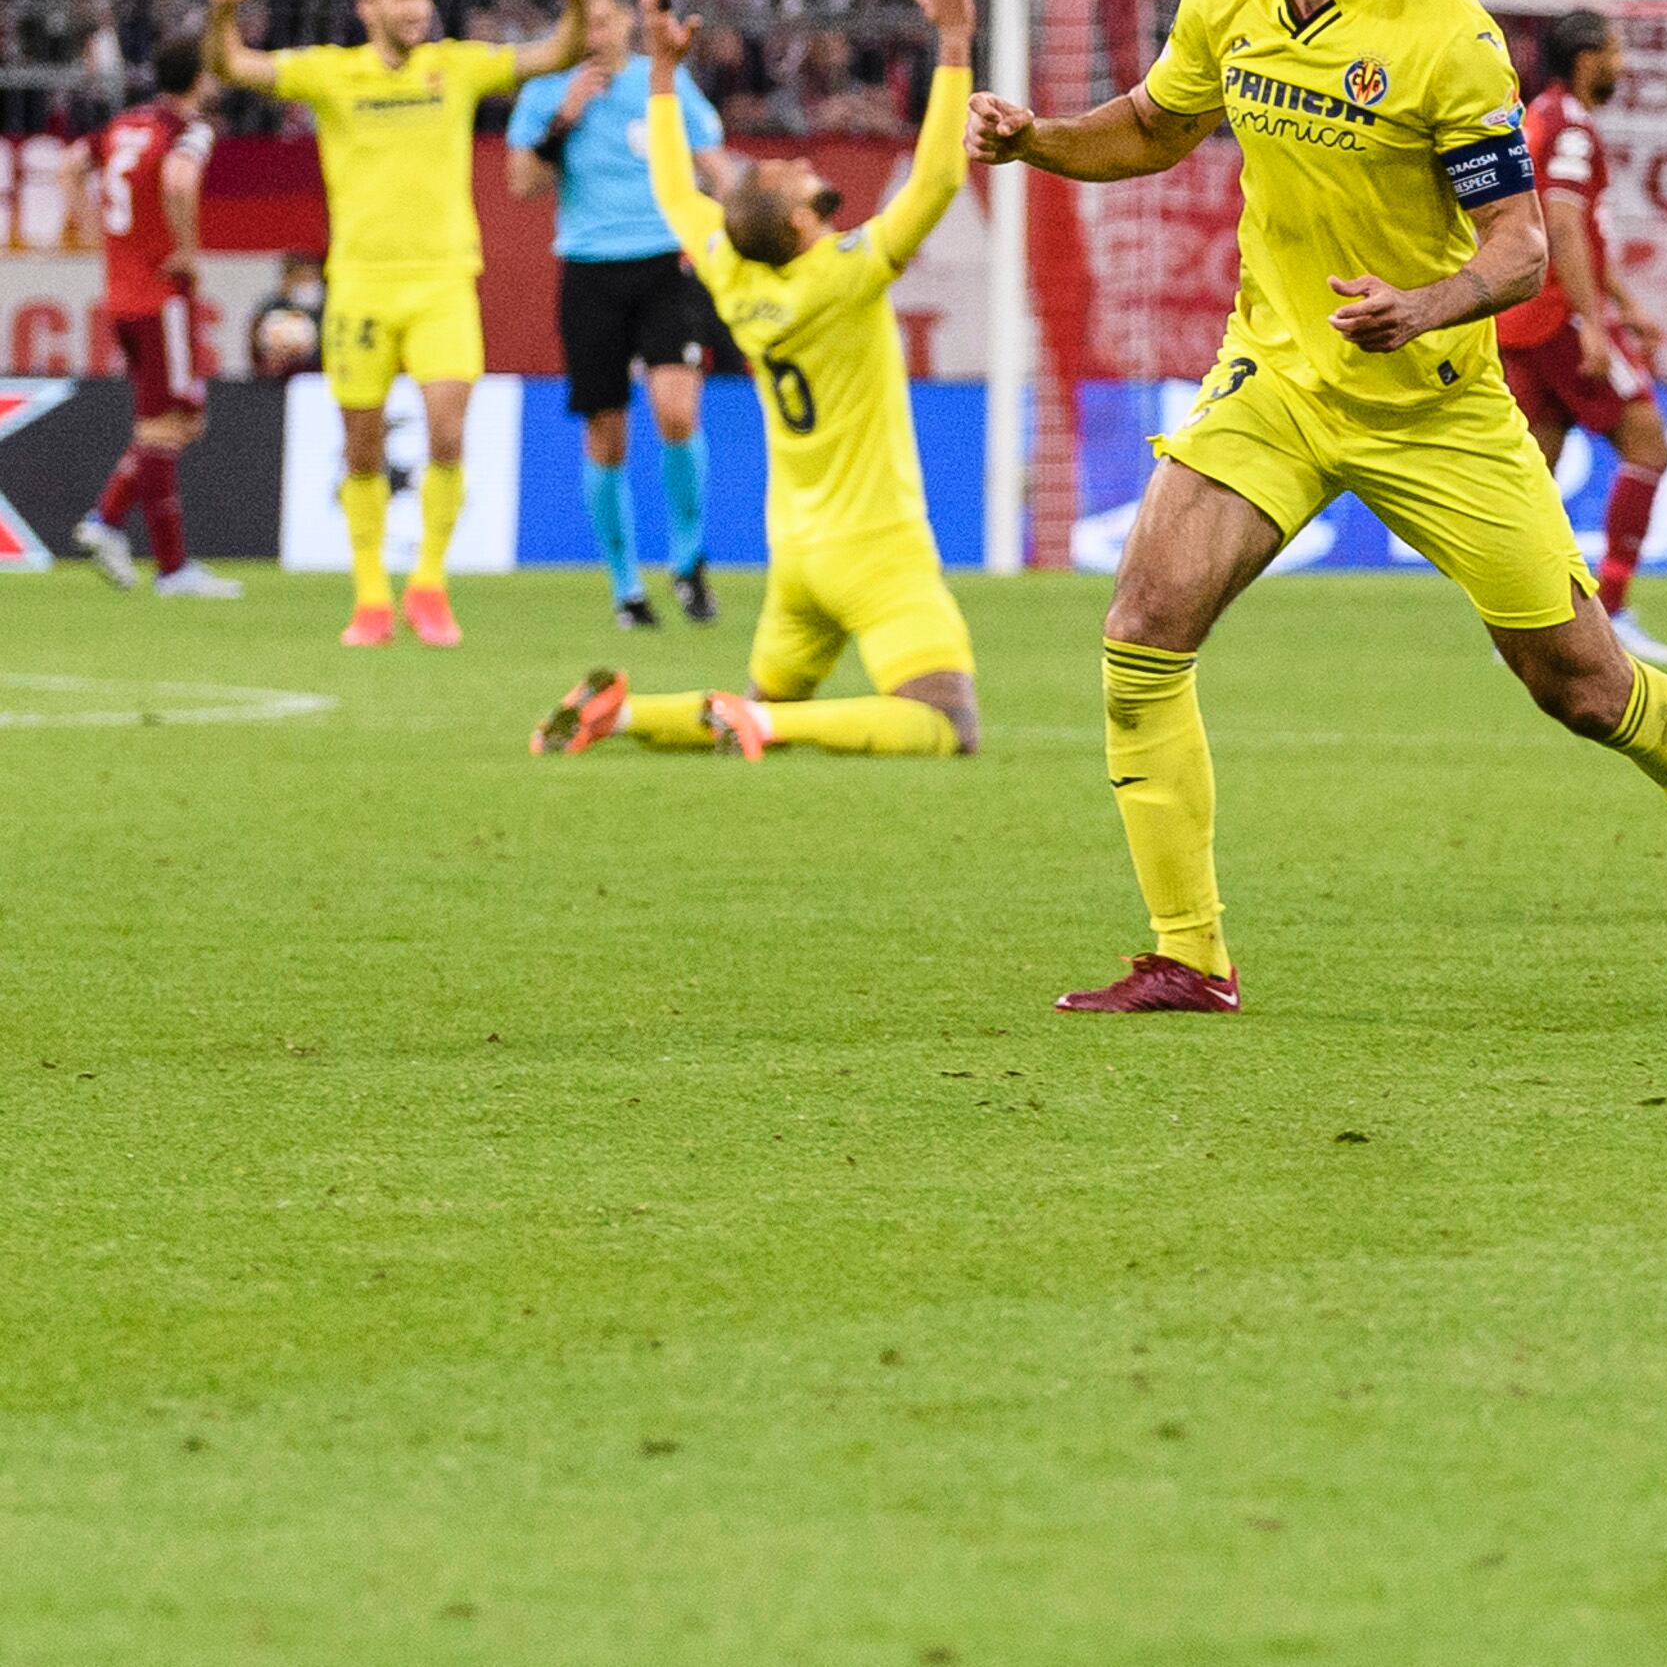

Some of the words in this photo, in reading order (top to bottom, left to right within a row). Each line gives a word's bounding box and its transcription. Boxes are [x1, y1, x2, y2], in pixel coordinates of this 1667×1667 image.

[1230, 105, 1366, 152] erámica
[1456, 152, 1499, 174] RACISM
[1211, 357, 1258, 399] 3
